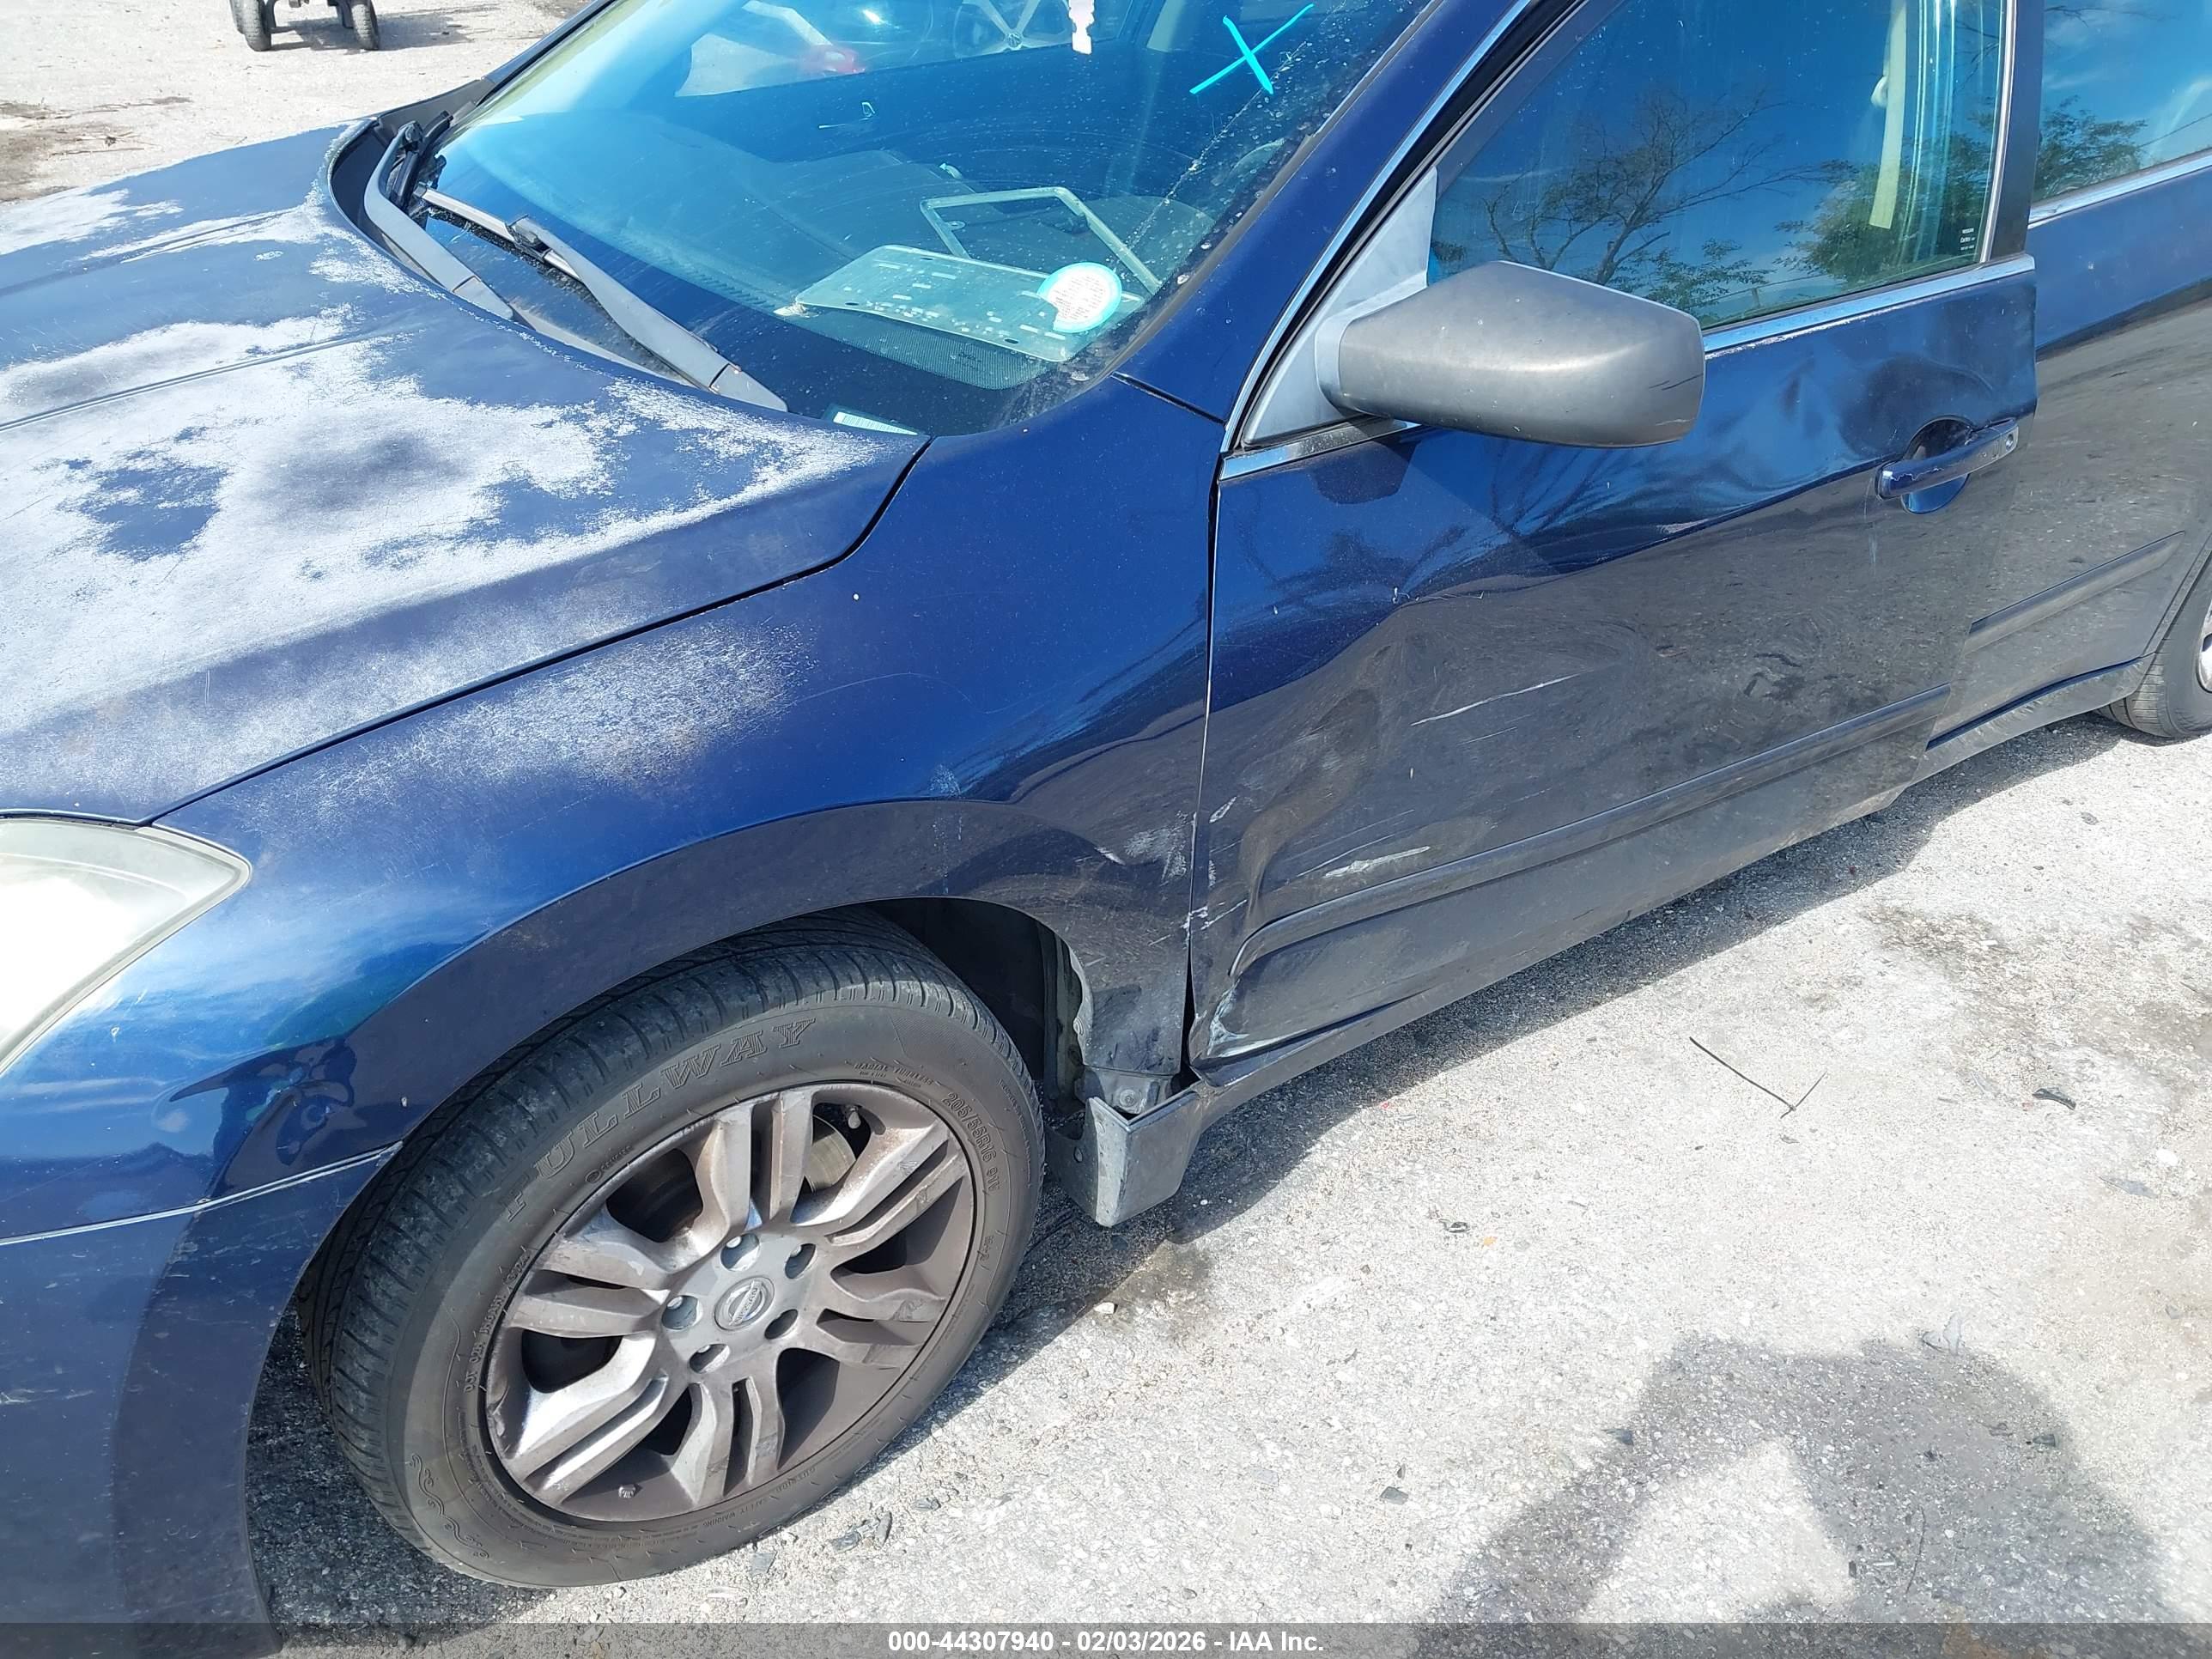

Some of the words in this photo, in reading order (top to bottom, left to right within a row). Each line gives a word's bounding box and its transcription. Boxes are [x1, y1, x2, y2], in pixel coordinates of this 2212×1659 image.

[506, 1018, 816, 1222] FULLWAY
[942, 1091, 997, 1163] 205/55R16
[734, 1286, 760, 1323] NISSAN
